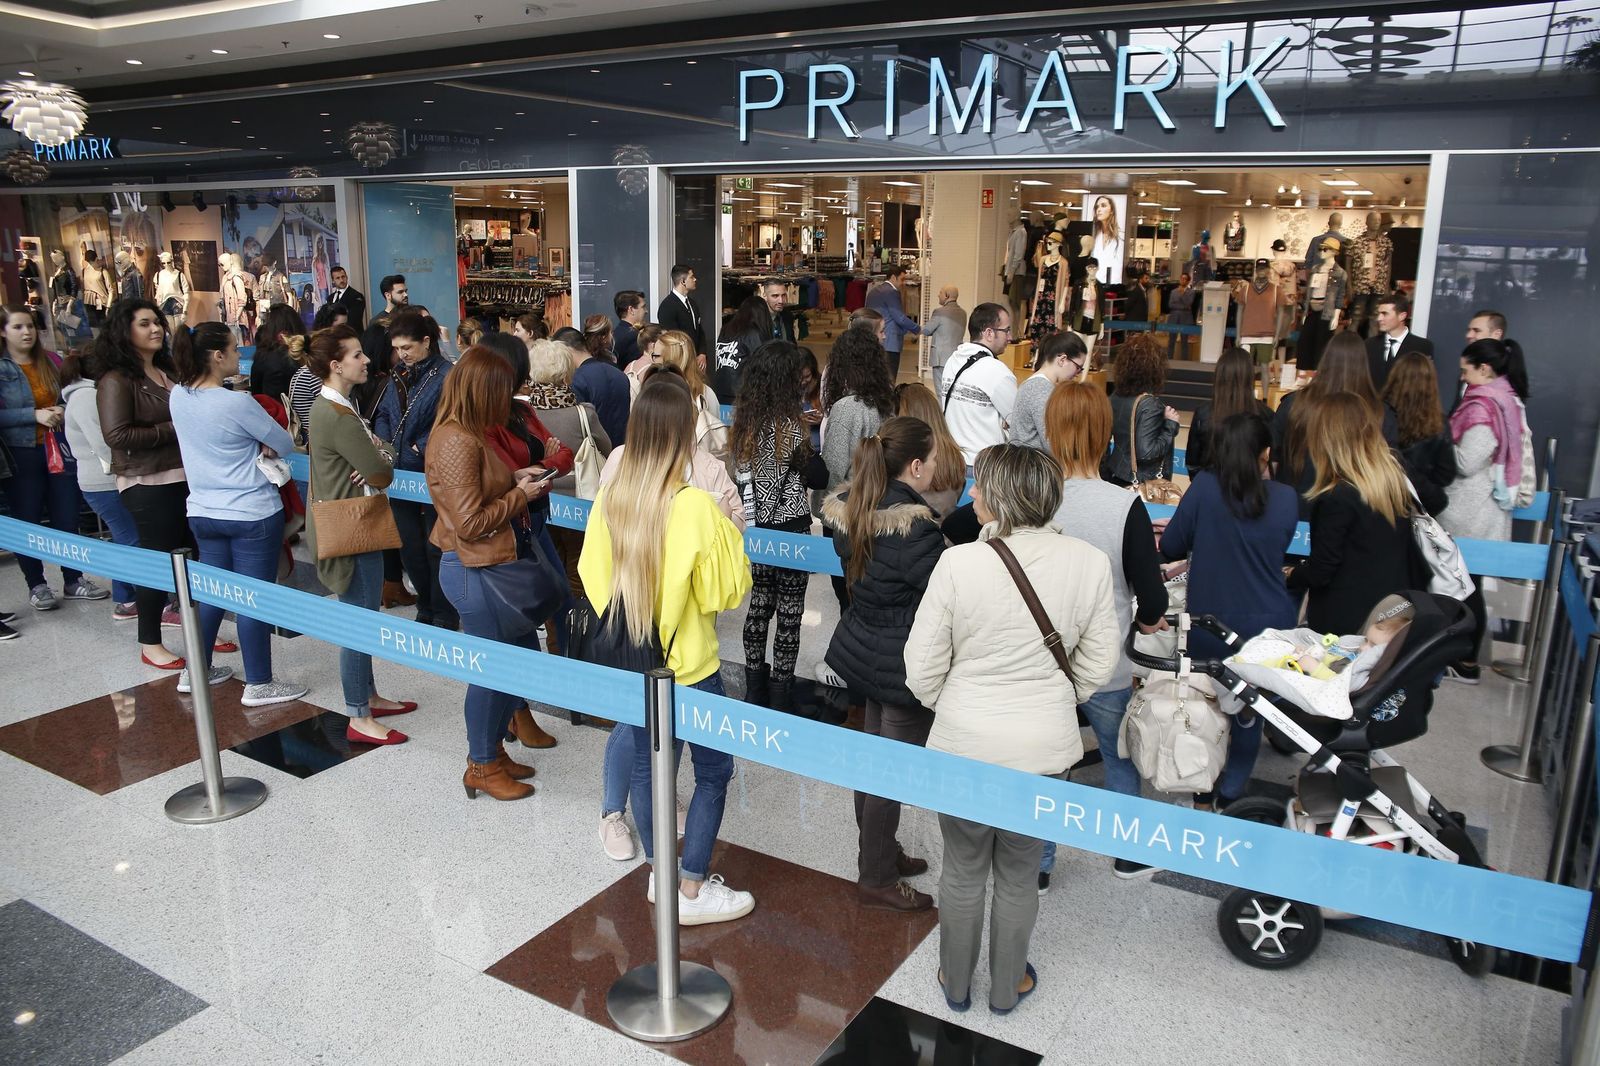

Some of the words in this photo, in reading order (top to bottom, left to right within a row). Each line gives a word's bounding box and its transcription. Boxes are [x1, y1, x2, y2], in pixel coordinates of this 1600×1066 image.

[739, 36, 1291, 142] PRIMARK
[34, 137, 114, 162] PRIMARK
[390, 478, 426, 495] MARK
[28, 533, 90, 564] PRIMARK
[749, 537, 806, 561] MARK
[191, 573, 257, 609] RIMARK
[380, 627, 483, 673] PRIMARK
[681, 703, 783, 753] IMARK
